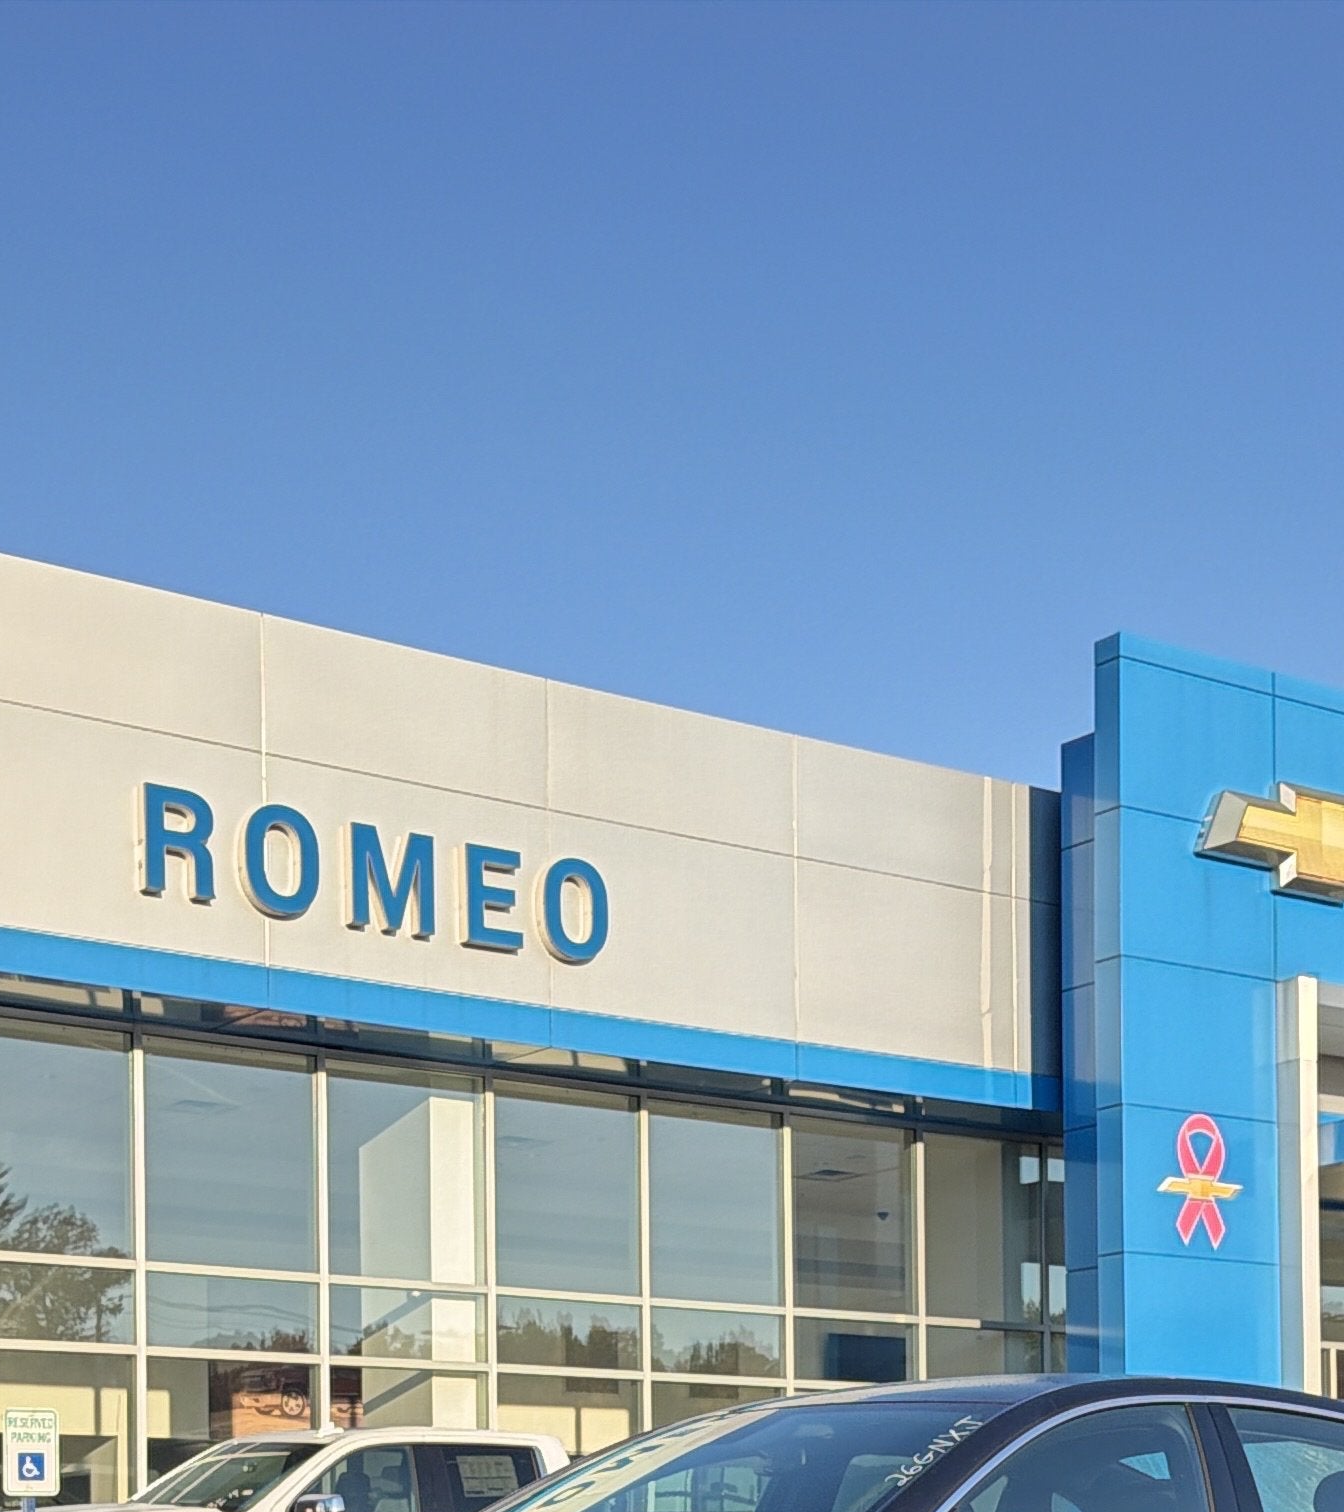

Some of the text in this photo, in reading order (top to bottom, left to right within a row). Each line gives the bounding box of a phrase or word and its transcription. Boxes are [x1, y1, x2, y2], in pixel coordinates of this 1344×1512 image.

[140, 782, 609, 965] ROMEO
[7, 1416, 54, 1430] RESERVED
[10, 1431, 52, 1444] PARKING
